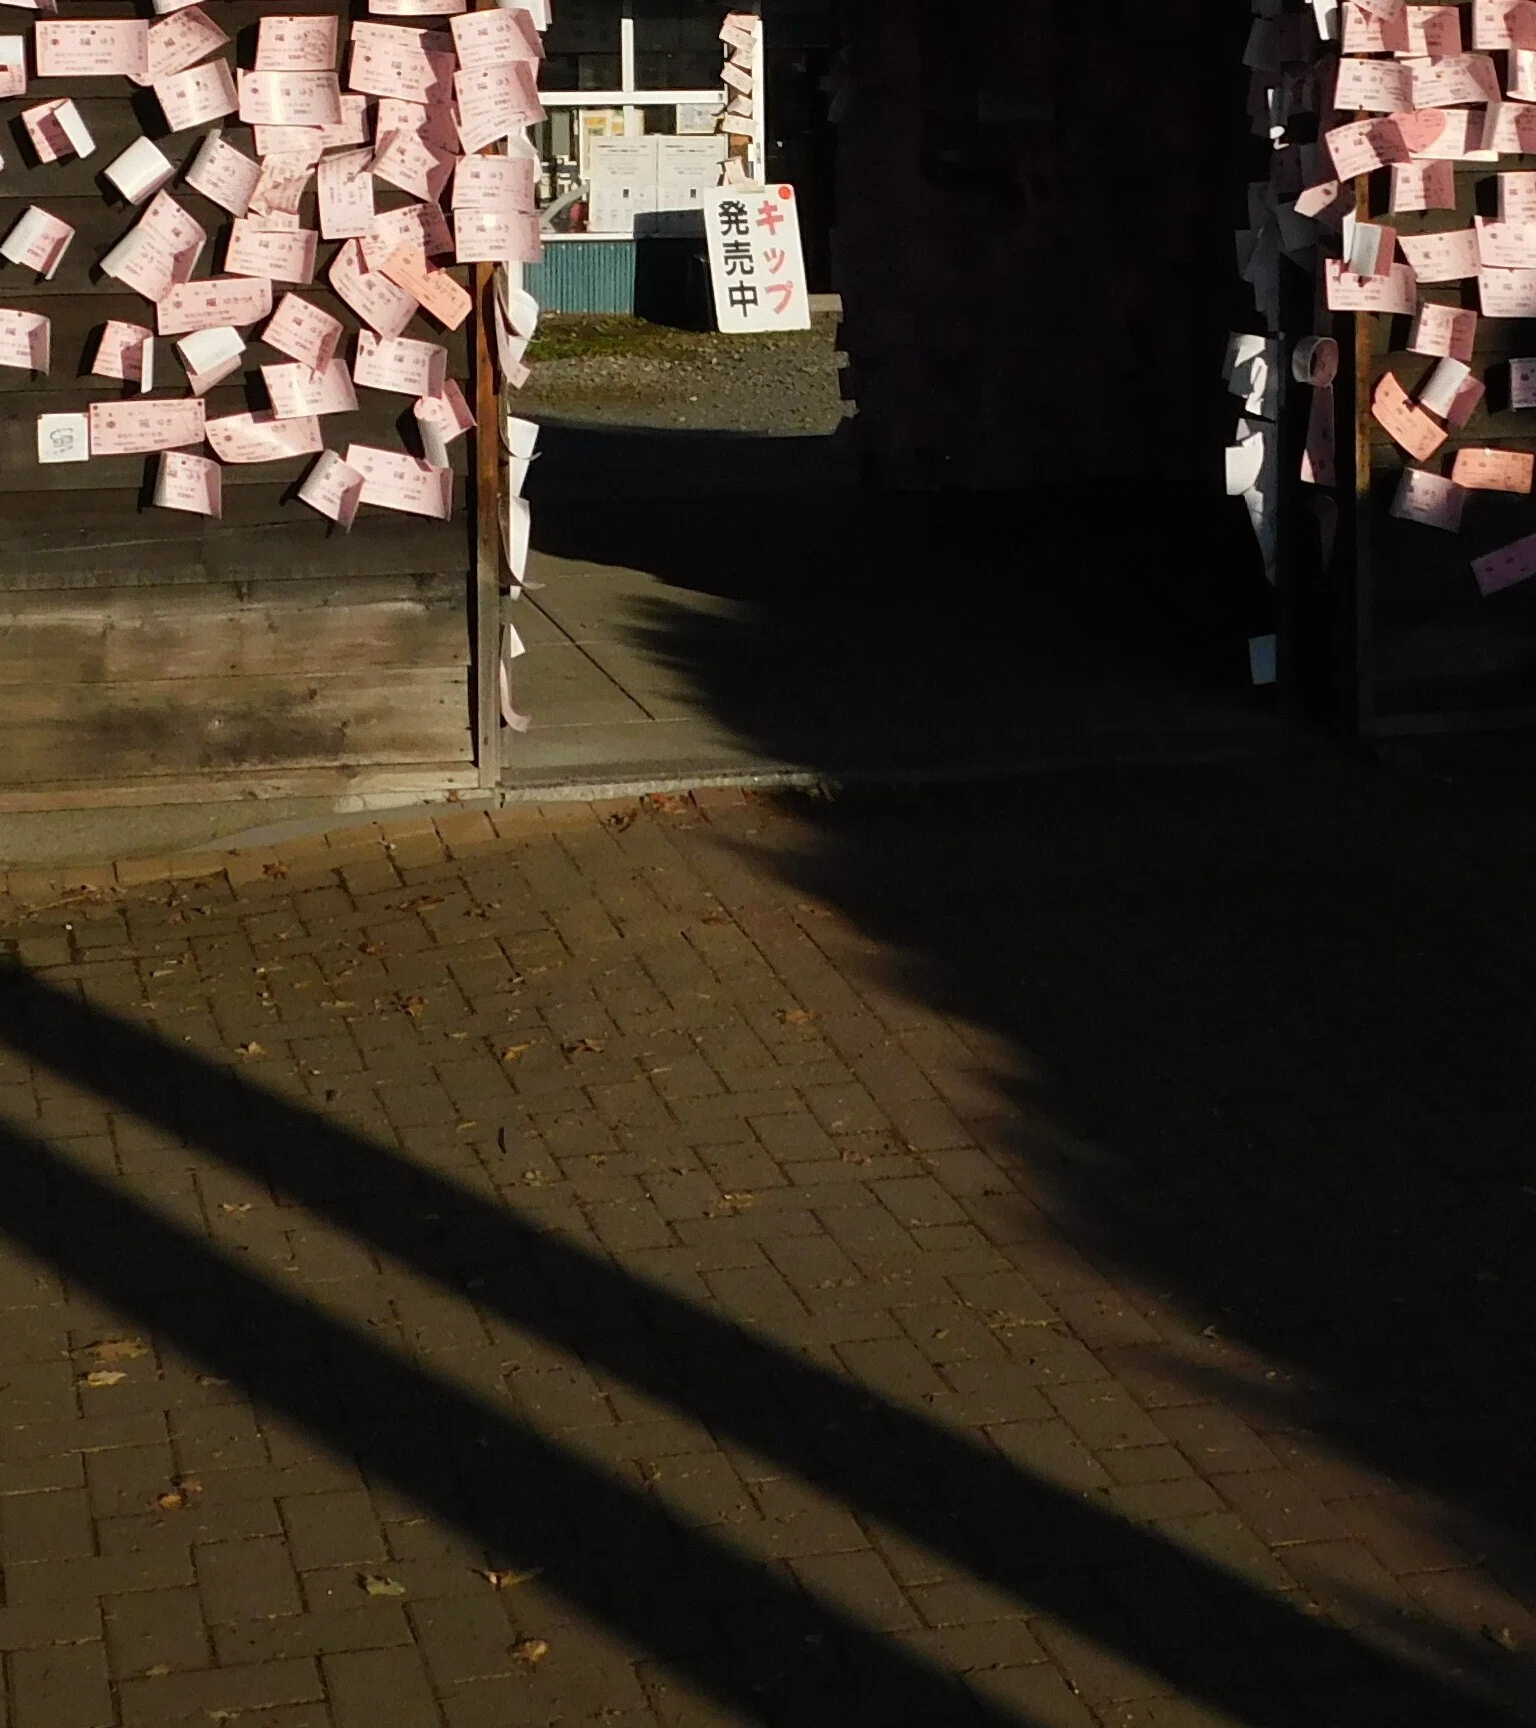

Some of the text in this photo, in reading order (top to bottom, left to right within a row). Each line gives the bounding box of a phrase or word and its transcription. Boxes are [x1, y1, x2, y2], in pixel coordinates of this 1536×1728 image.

[719, 200, 759, 318] 発売中
[757, 201, 793, 314] キップ
